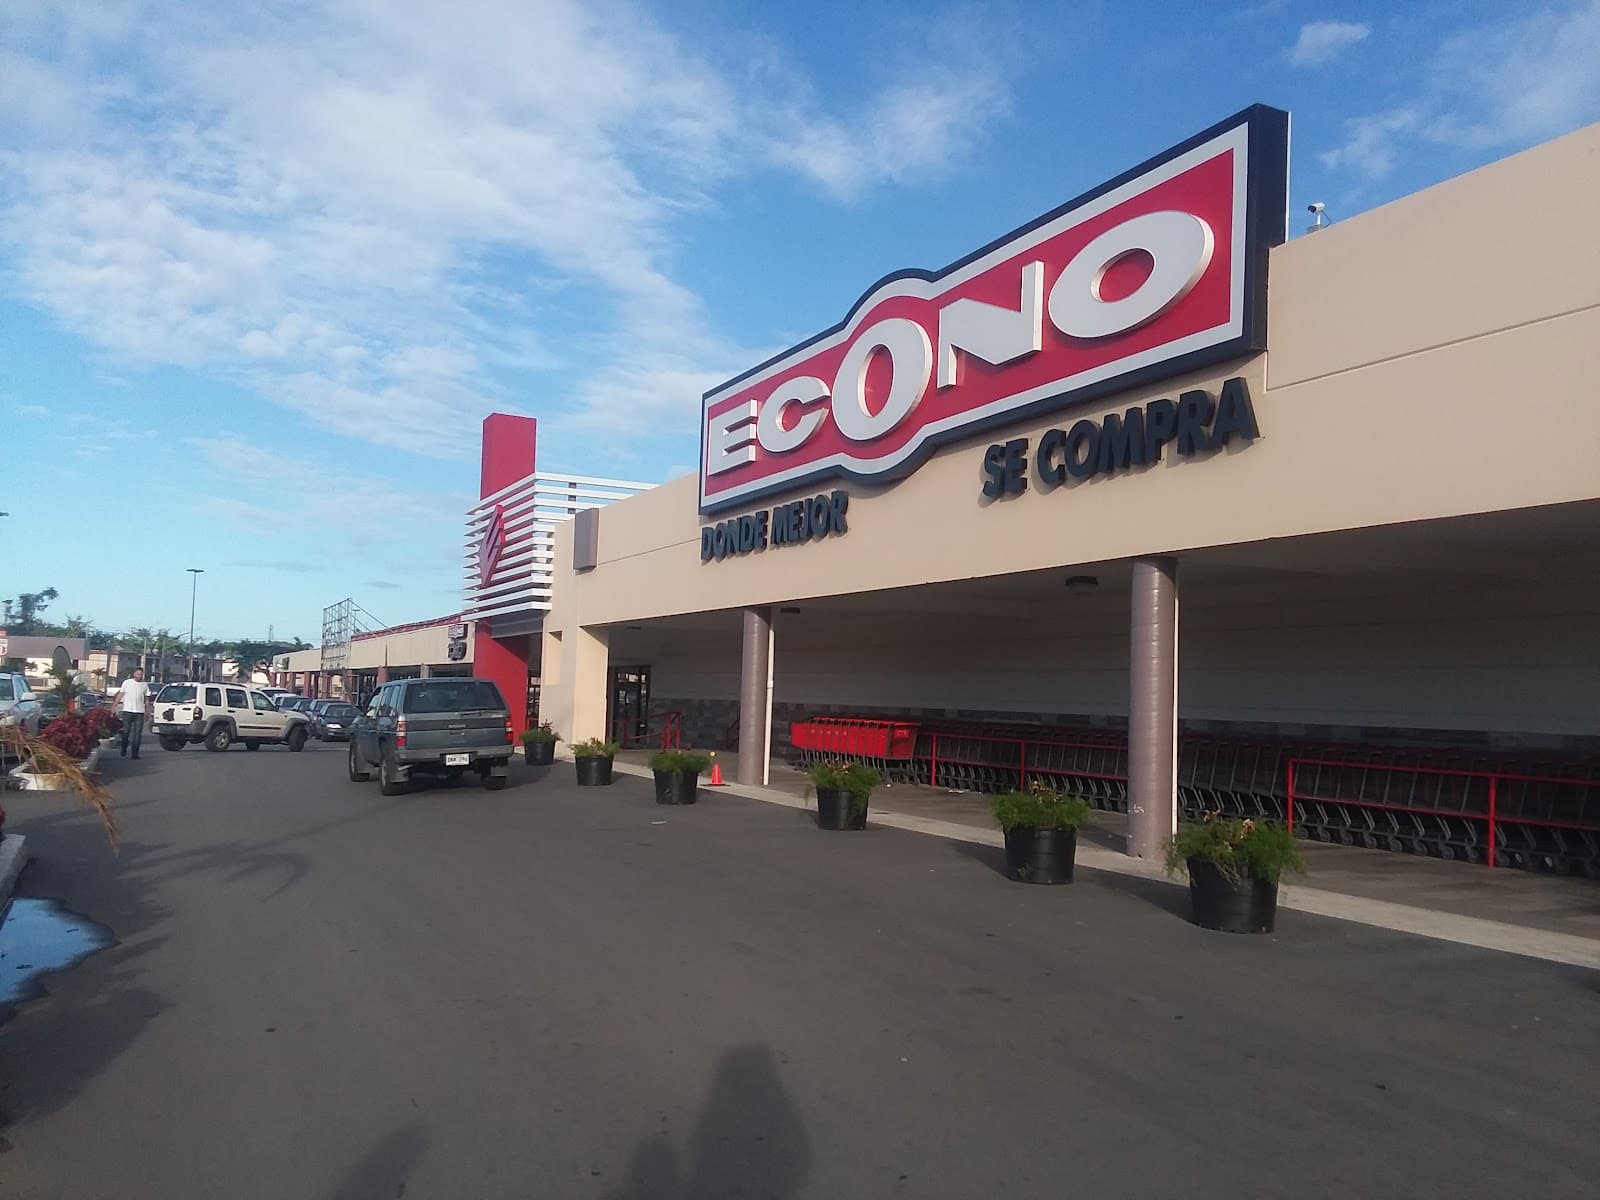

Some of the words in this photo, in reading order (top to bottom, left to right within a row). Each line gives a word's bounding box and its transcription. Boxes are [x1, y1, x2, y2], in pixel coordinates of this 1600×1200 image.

[708, 210, 1216, 476] ECONO
[701, 511, 768, 560] DONDE
[771, 490, 849, 544] MEJOR
[983, 438, 1029, 497] SE
[1037, 377, 1260, 485] COMPRA
